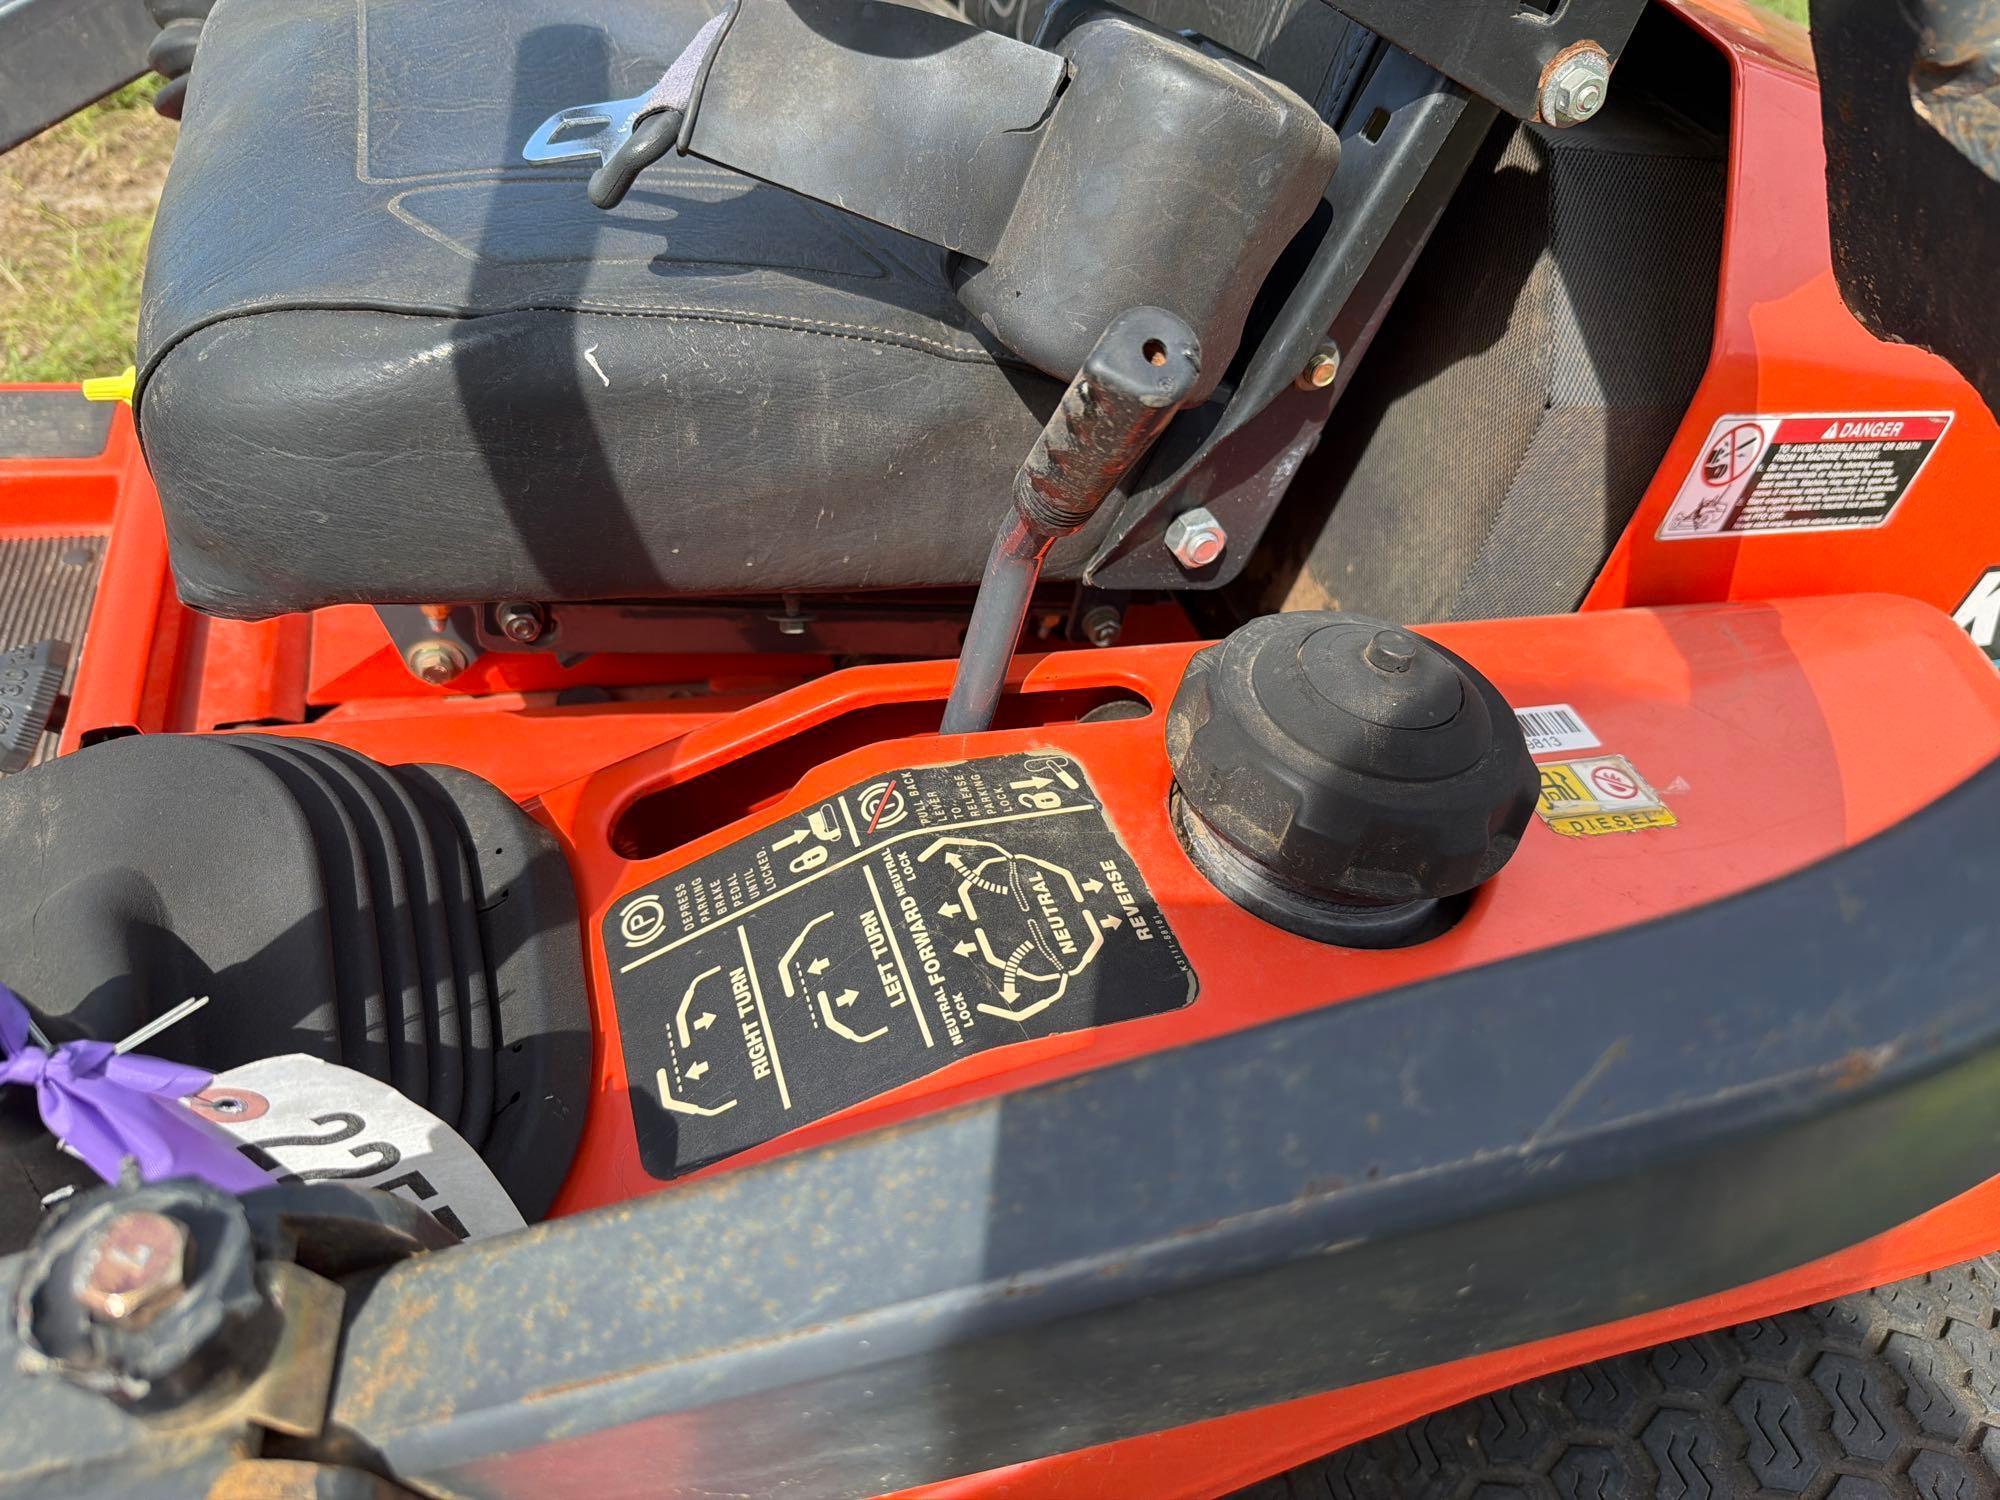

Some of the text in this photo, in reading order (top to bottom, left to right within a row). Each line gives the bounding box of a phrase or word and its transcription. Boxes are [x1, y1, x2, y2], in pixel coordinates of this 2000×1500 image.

[1778, 444, 1791, 453] TO
[1791, 443, 1816, 452] AVOID
[1882, 442, 1895, 450] OR
[1838, 421, 1903, 438] DANGER
[901, 772, 931, 826] PULL BACK
[927, 791, 947, 822] LEVER
[954, 775, 980, 817] RELEASE
[970, 774, 997, 815] PARKING
[991, 784, 1013, 813] LOCK.
[1570, 815, 1658, 832] DIESEL
[744, 867, 760, 900] UNTIL
[756, 846, 777, 892] LOCKED.
[881, 847, 907, 894] NEUTRAL
[897, 851, 916, 881] LOCK
[674, 883, 695, 932] DEPRESS
[690, 877, 711, 924] PARKING
[710, 879, 728, 916] BRAKE
[727, 872, 744, 908] PEDAL
[1099, 859, 1154, 941] REVERSE
[1029, 871, 1078, 954] NEUTRAL
[859, 910, 906, 1008] LEFT TURN
[900, 896, 947, 983] FORWARD
[729, 966, 772, 1080] RIGHT TURN
[936, 985, 964, 1047] NEUTRAL
[952, 991, 974, 1028] LOCK
